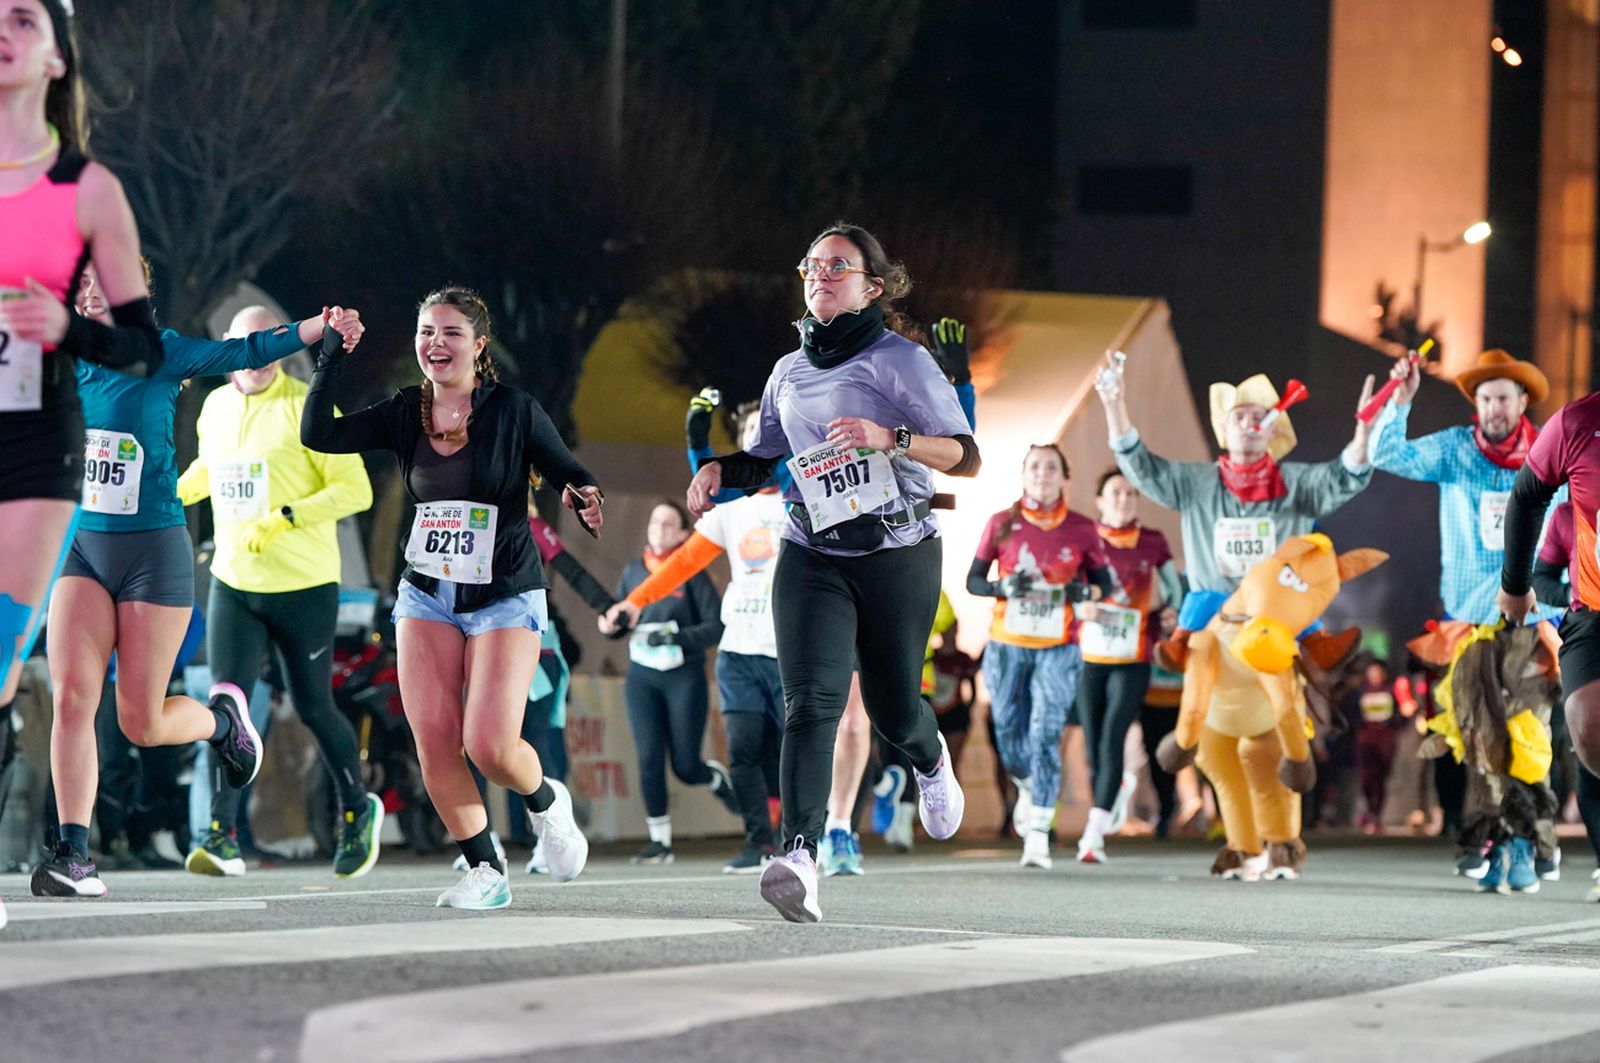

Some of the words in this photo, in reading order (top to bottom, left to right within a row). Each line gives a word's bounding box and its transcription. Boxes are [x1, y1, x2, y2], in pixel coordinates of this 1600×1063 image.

[809, 448, 836, 465] NOCHE
[84, 458, 126, 486] 905
[804, 465, 822, 479] SAN
[817, 459, 871, 498] 7507
[221, 481, 254, 498] 4510
[453, 510, 463, 518] DE
[420, 519, 435, 528] SAN
[425, 530, 475, 555] 6213
[1226, 540, 1264, 555] 4033
